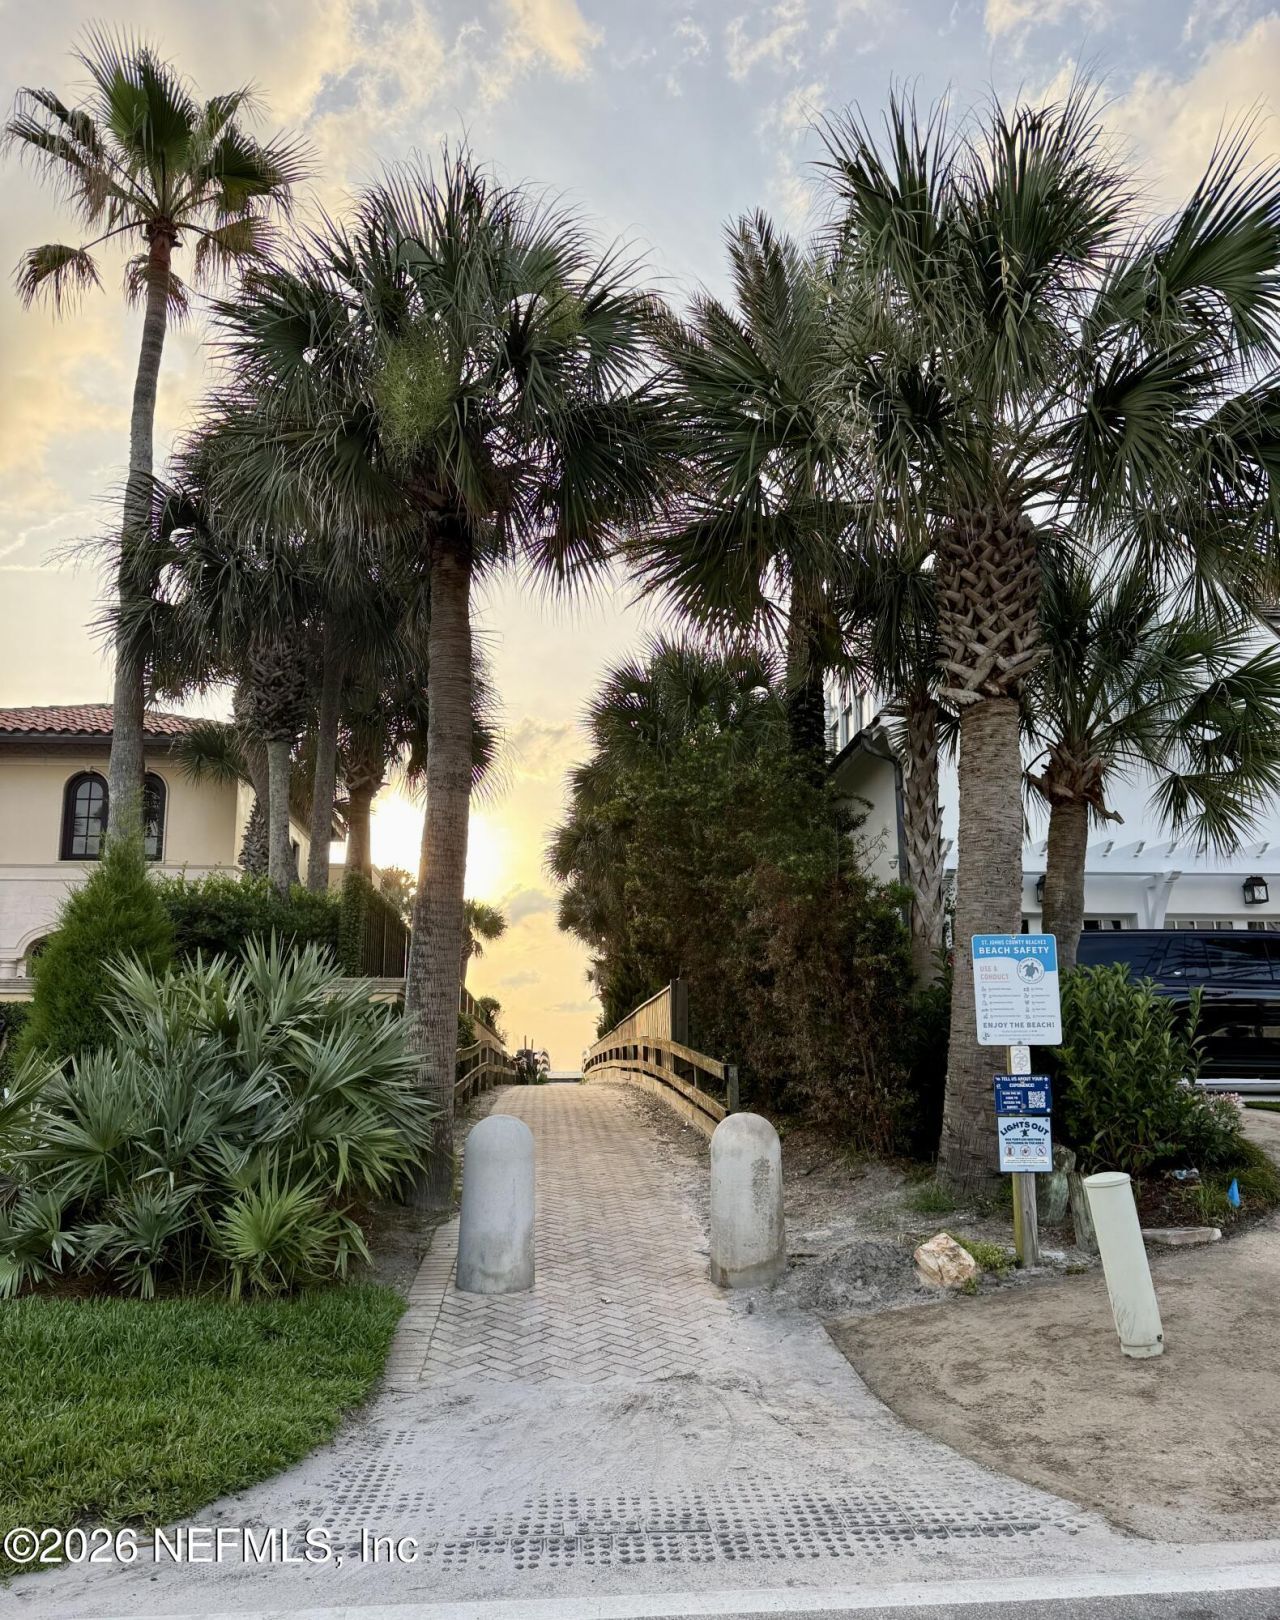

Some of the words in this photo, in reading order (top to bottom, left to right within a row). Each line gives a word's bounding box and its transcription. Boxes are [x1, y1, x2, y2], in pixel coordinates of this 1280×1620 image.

[1014, 946, 1049, 954] SAFETY
[1000, 1121, 1030, 1136] LIGHTS
[1031, 1123, 1049, 1136] OUT
